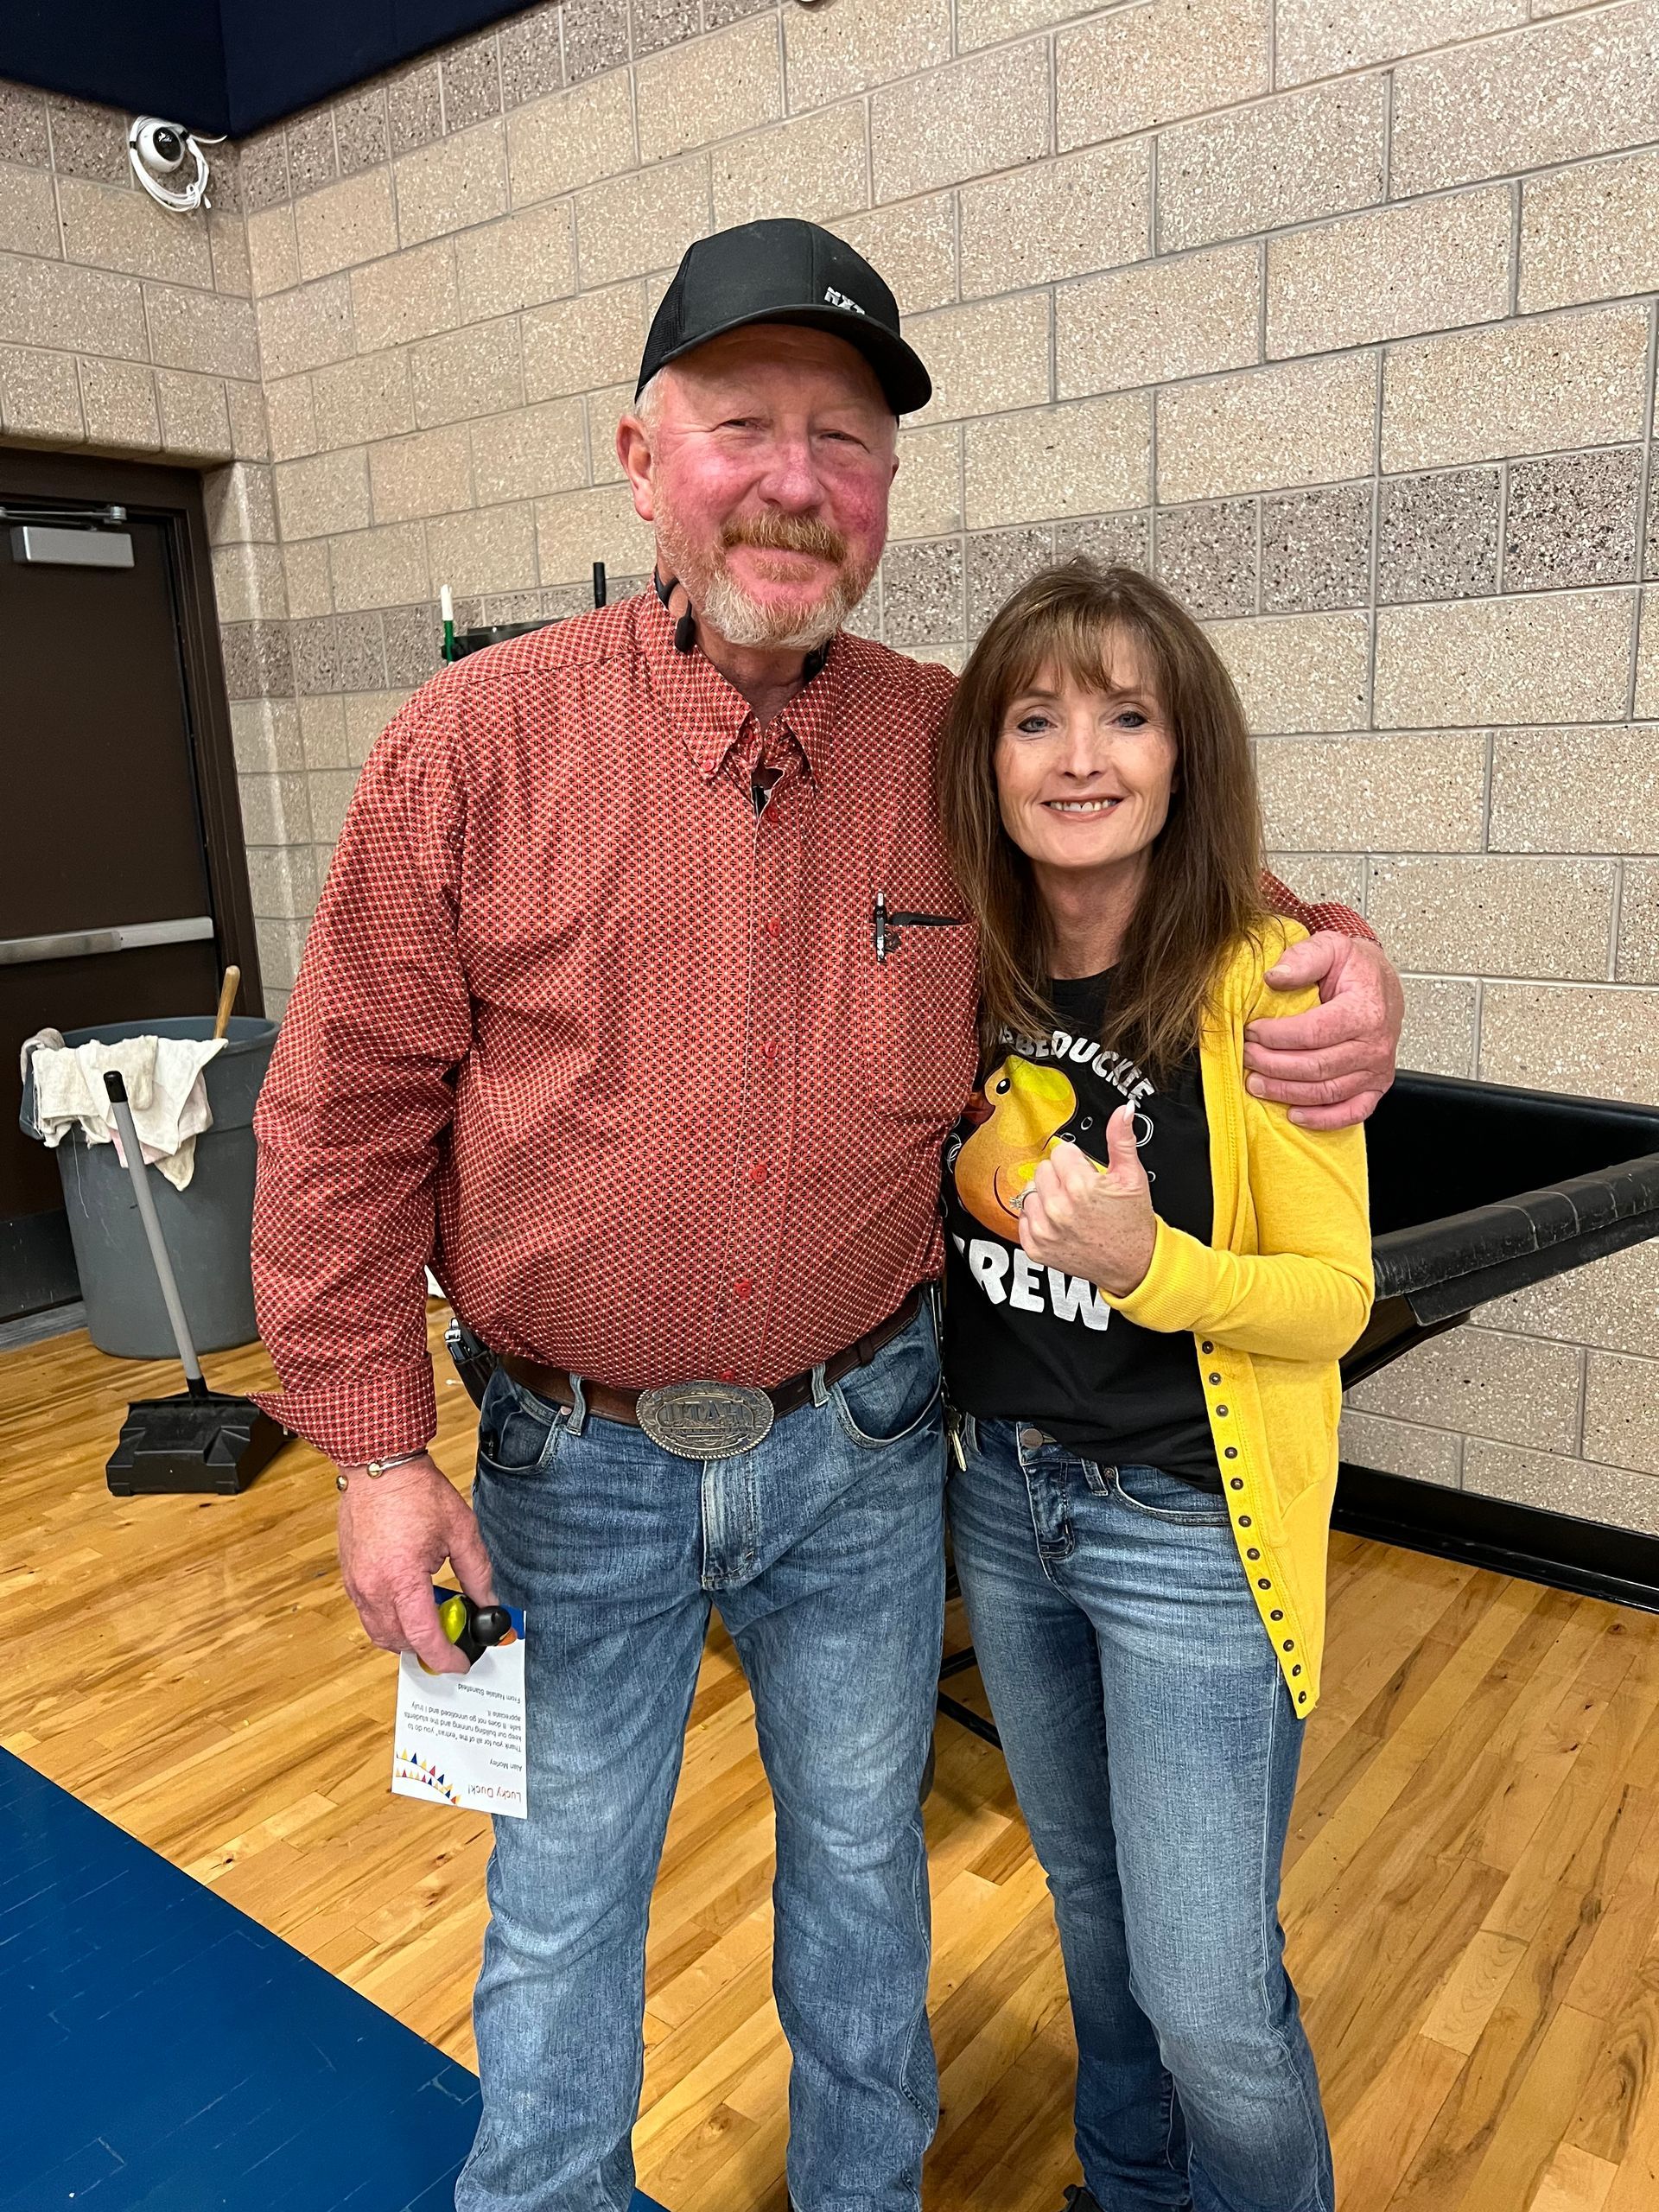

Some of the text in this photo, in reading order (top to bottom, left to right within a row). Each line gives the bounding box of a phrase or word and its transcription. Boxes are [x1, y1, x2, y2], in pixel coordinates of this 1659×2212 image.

[952, 1232, 1110, 1331] REW
[664, 1401, 744, 1424] UTAH
[486, 1691, 505, 1700] Natalie
[506, 1695, 520, 1704] From
[411, 1701, 423, 1712] truly
[404, 1712, 428, 1722] students
[442, 1710, 467, 1719] unnoticed
[493, 1712, 521, 1721] appreciate
[453, 1721, 474, 1732] running
[436, 1730, 457, 1740] "extras"
[475, 1726, 496, 1738] building
[508, 1733, 521, 1742] keep
[505, 1744, 521, 1752] Thank
[510, 1764, 522, 1772] Alan
[468, 1785, 521, 1802] Lucky Duck!
